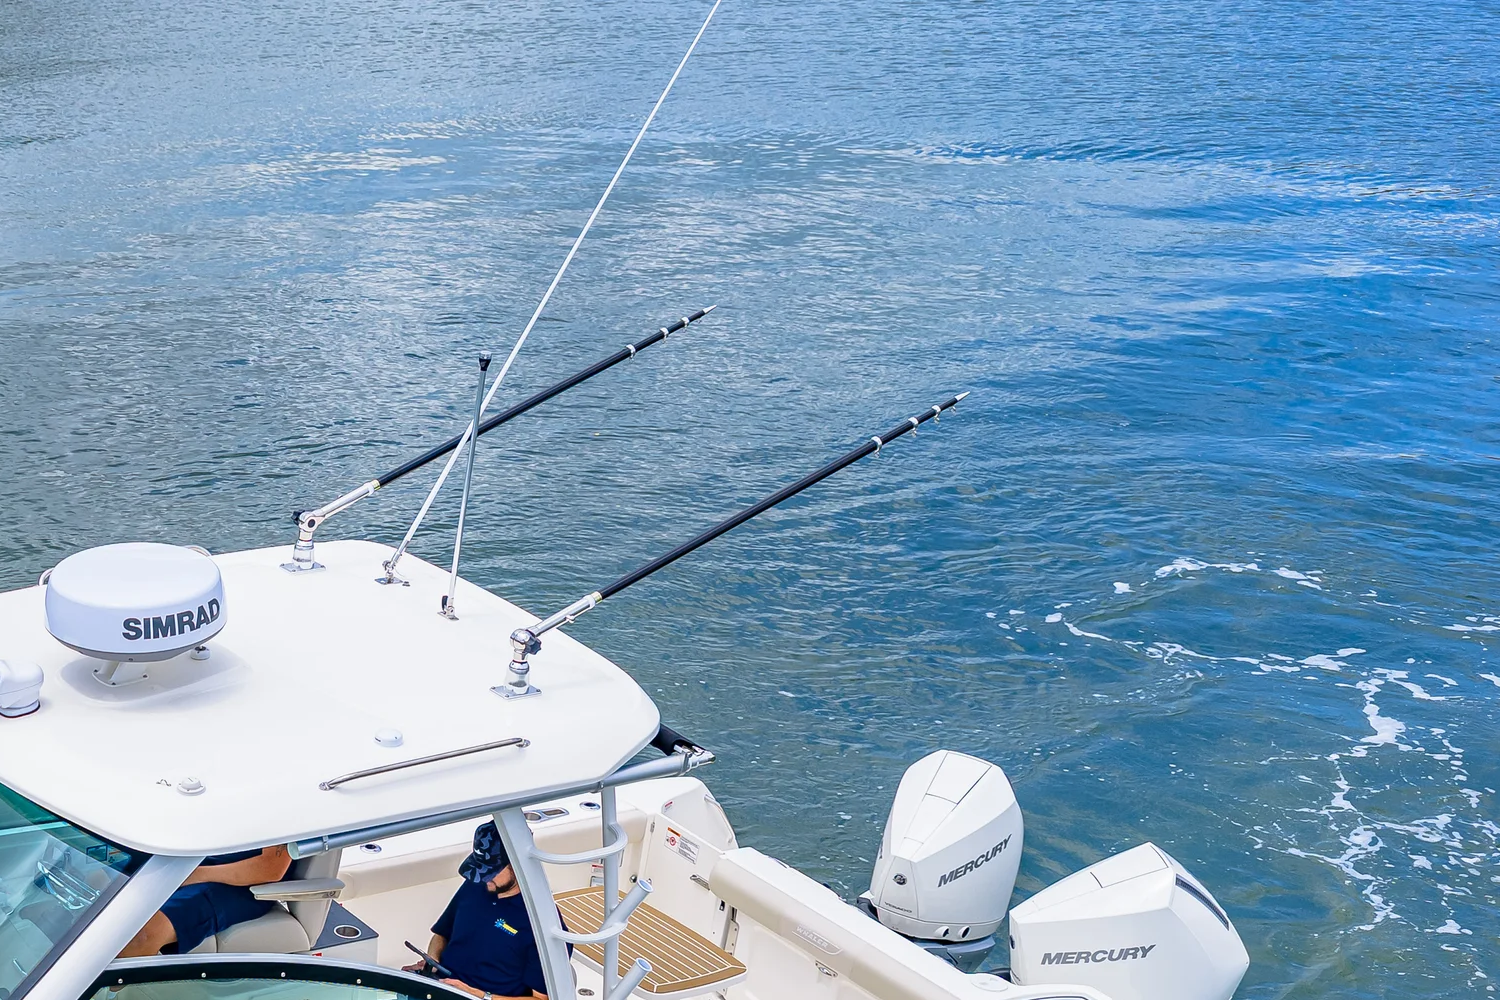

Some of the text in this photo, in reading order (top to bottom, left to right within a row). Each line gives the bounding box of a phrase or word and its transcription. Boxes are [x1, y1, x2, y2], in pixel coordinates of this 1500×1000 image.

[122, 598, 220, 641] SIMRAD
[937, 833, 1012, 888] MERCURY
[1040, 943, 1156, 965] MERCURY
